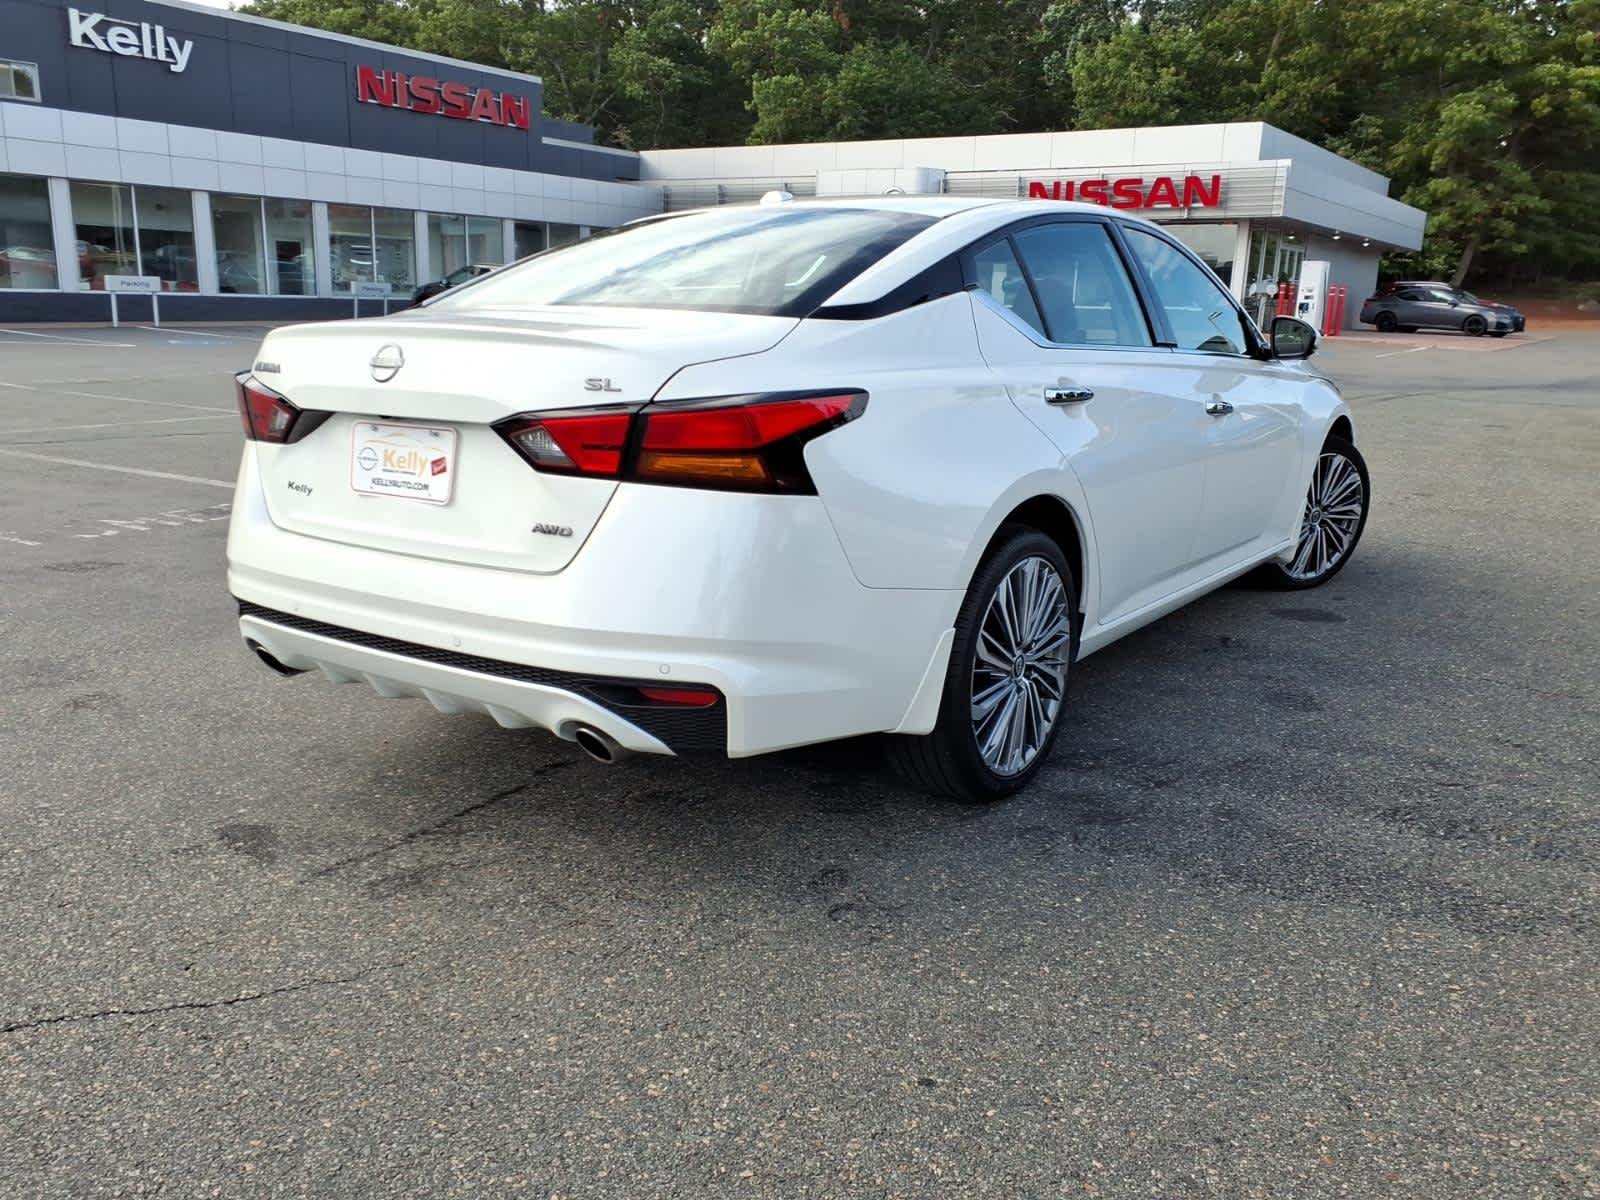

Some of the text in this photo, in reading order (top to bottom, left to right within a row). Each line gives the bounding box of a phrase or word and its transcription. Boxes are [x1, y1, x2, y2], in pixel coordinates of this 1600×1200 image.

[68, 8, 193, 72] Kelly
[356, 64, 530, 129] NISSAN
[1029, 174, 1221, 209] NISSAN
[120, 279, 151, 289] Parking
[584, 378, 622, 392] SL
[383, 449, 428, 477] Kelly
[287, 480, 313, 496] Kelly
[371, 477, 429, 490] KELLYAUTO.COM
[531, 522, 574, 537] AWD
